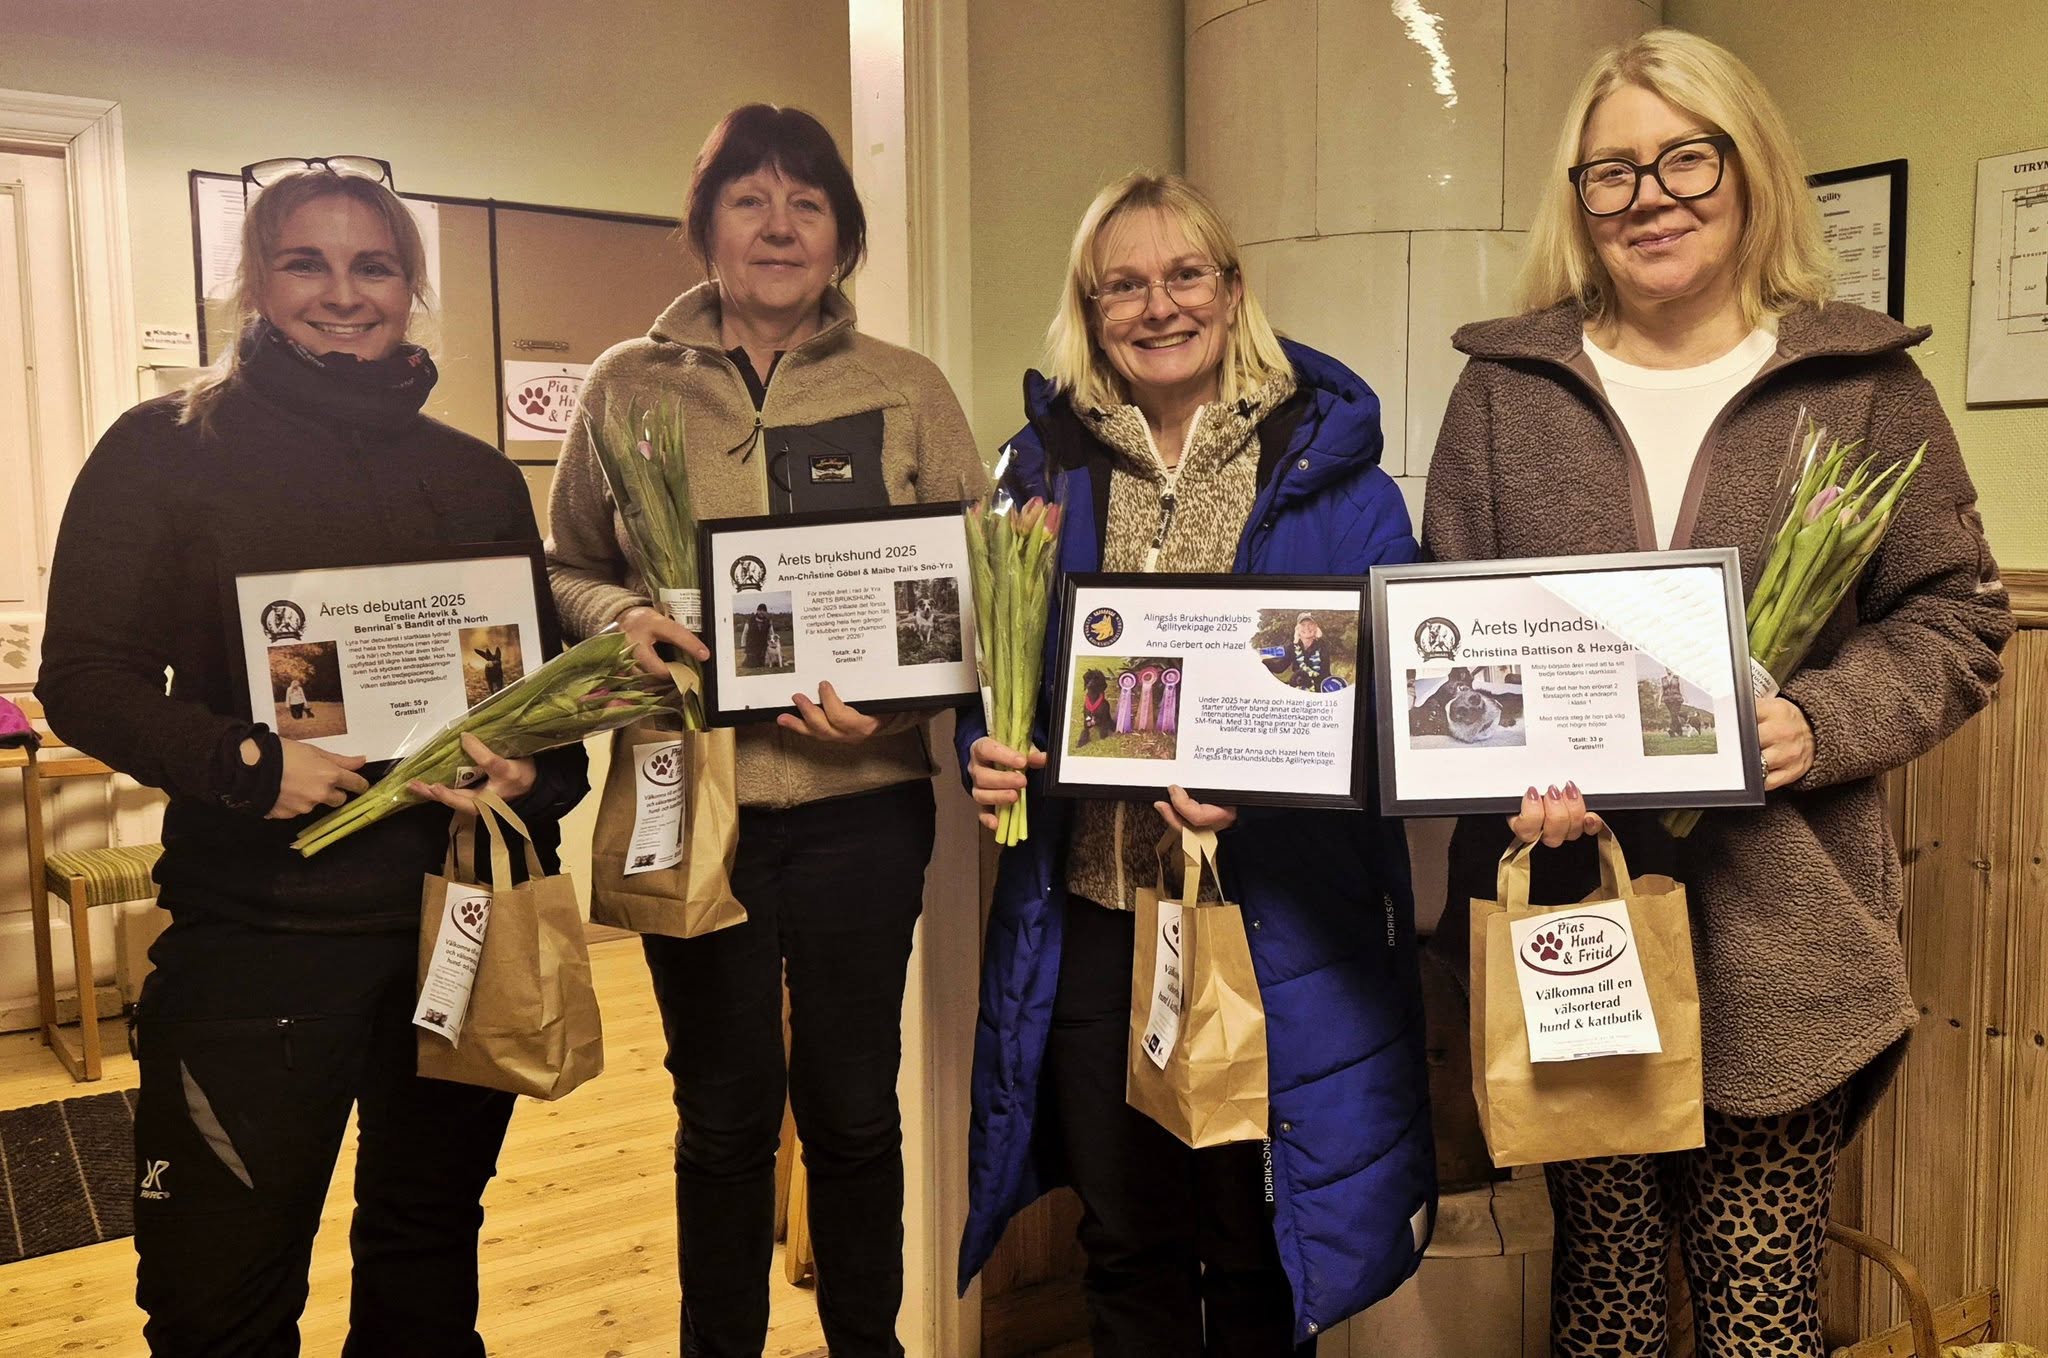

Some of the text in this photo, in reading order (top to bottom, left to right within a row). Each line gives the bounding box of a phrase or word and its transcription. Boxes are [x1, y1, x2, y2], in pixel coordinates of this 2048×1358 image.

[778, 545, 916, 566] Årets brukshund 2025
[778, 571, 834, 581] Ann-Christine
[320, 594, 465, 616] Årets debutant 2025
[384, 613, 415, 622] Emelie
[418, 610, 449, 619] Arlevik
[404, 620, 434, 629] Bandit
[437, 618, 445, 626] of
[464, 615, 488, 623] North
[1144, 613, 1251, 623] Alingsås Brukshundklubbs
[1157, 622, 1237, 632] Agilityekipage 2025
[1472, 618, 1517, 635] Årets
[1146, 640, 1167, 648] Anna
[1170, 640, 1202, 648] Gerbert
[1205, 641, 1220, 649] och
[1463, 648, 1517, 658] Christina
[1522, 646, 1572, 655] Battison
[1577, 644, 1585, 653] &
[1220, 725, 1256, 733] kvalificerat
[1258, 726, 1267, 734] sig
[1558, 922, 1584, 935] Pias
[1571, 930, 1603, 947] Hund
[1563, 944, 1612, 964] & Fritid
[1536, 979, 1631, 1000] Välkomna till en
[1555, 995, 1620, 1014] välsorterad
[1540, 1010, 1642, 1032] hund & kattbutik
[1262, 1136, 1274, 1202] DIDRIKSONS
